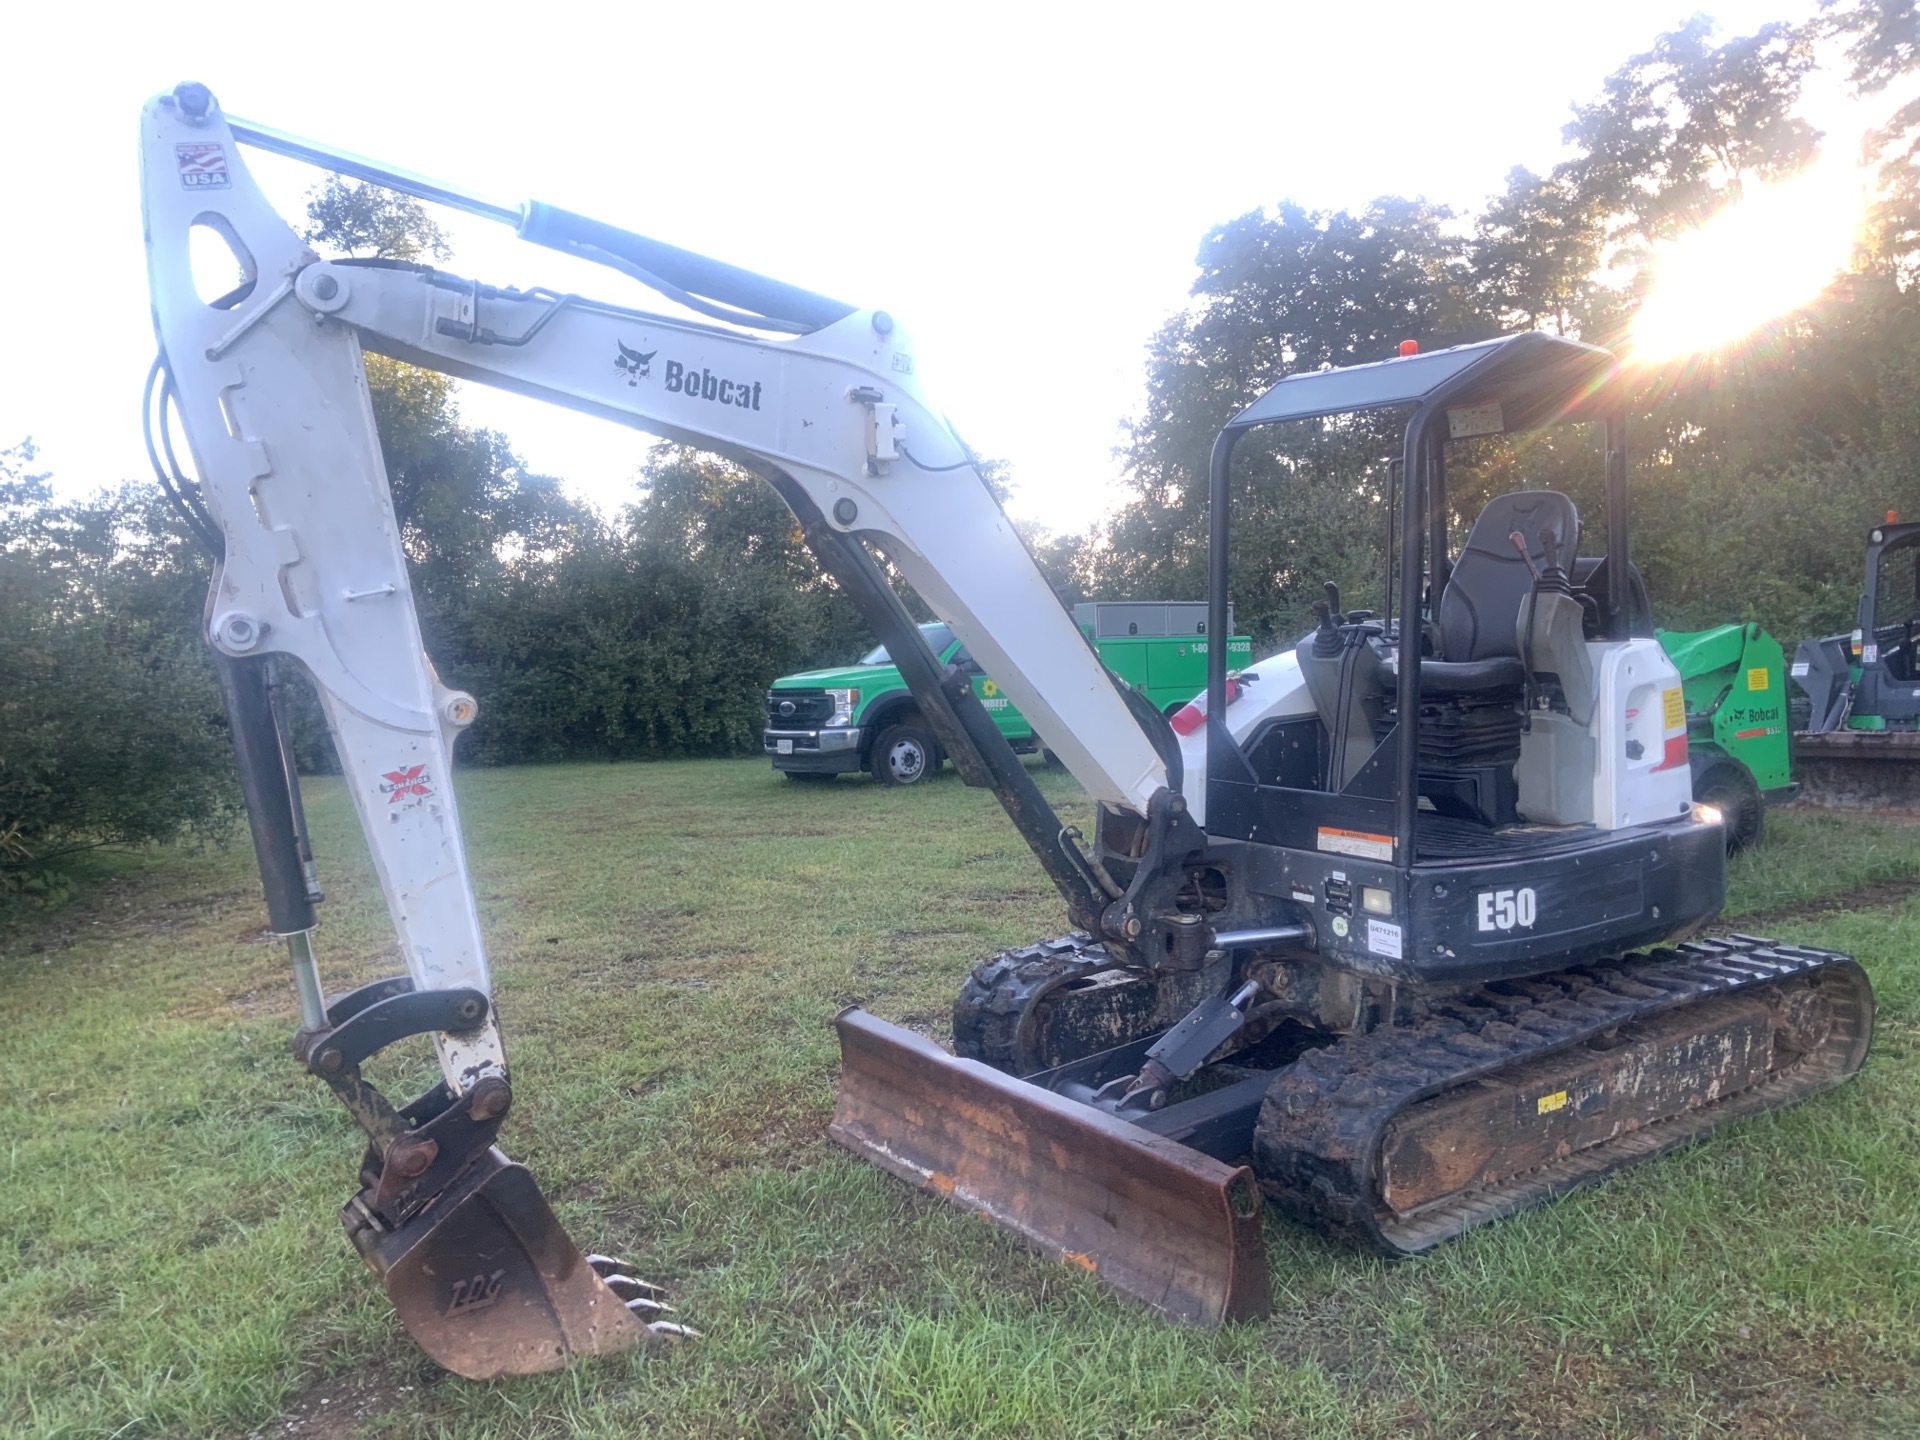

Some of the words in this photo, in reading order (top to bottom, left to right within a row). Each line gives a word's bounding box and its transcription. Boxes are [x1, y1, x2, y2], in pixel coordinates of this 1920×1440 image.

[184, 173, 225, 185] USA
[665, 360, 762, 411] Bobcat
[1748, 706, 1779, 722] Bobcat
[1478, 888, 1535, 931] E50
[1369, 925, 1399, 938] U471216
